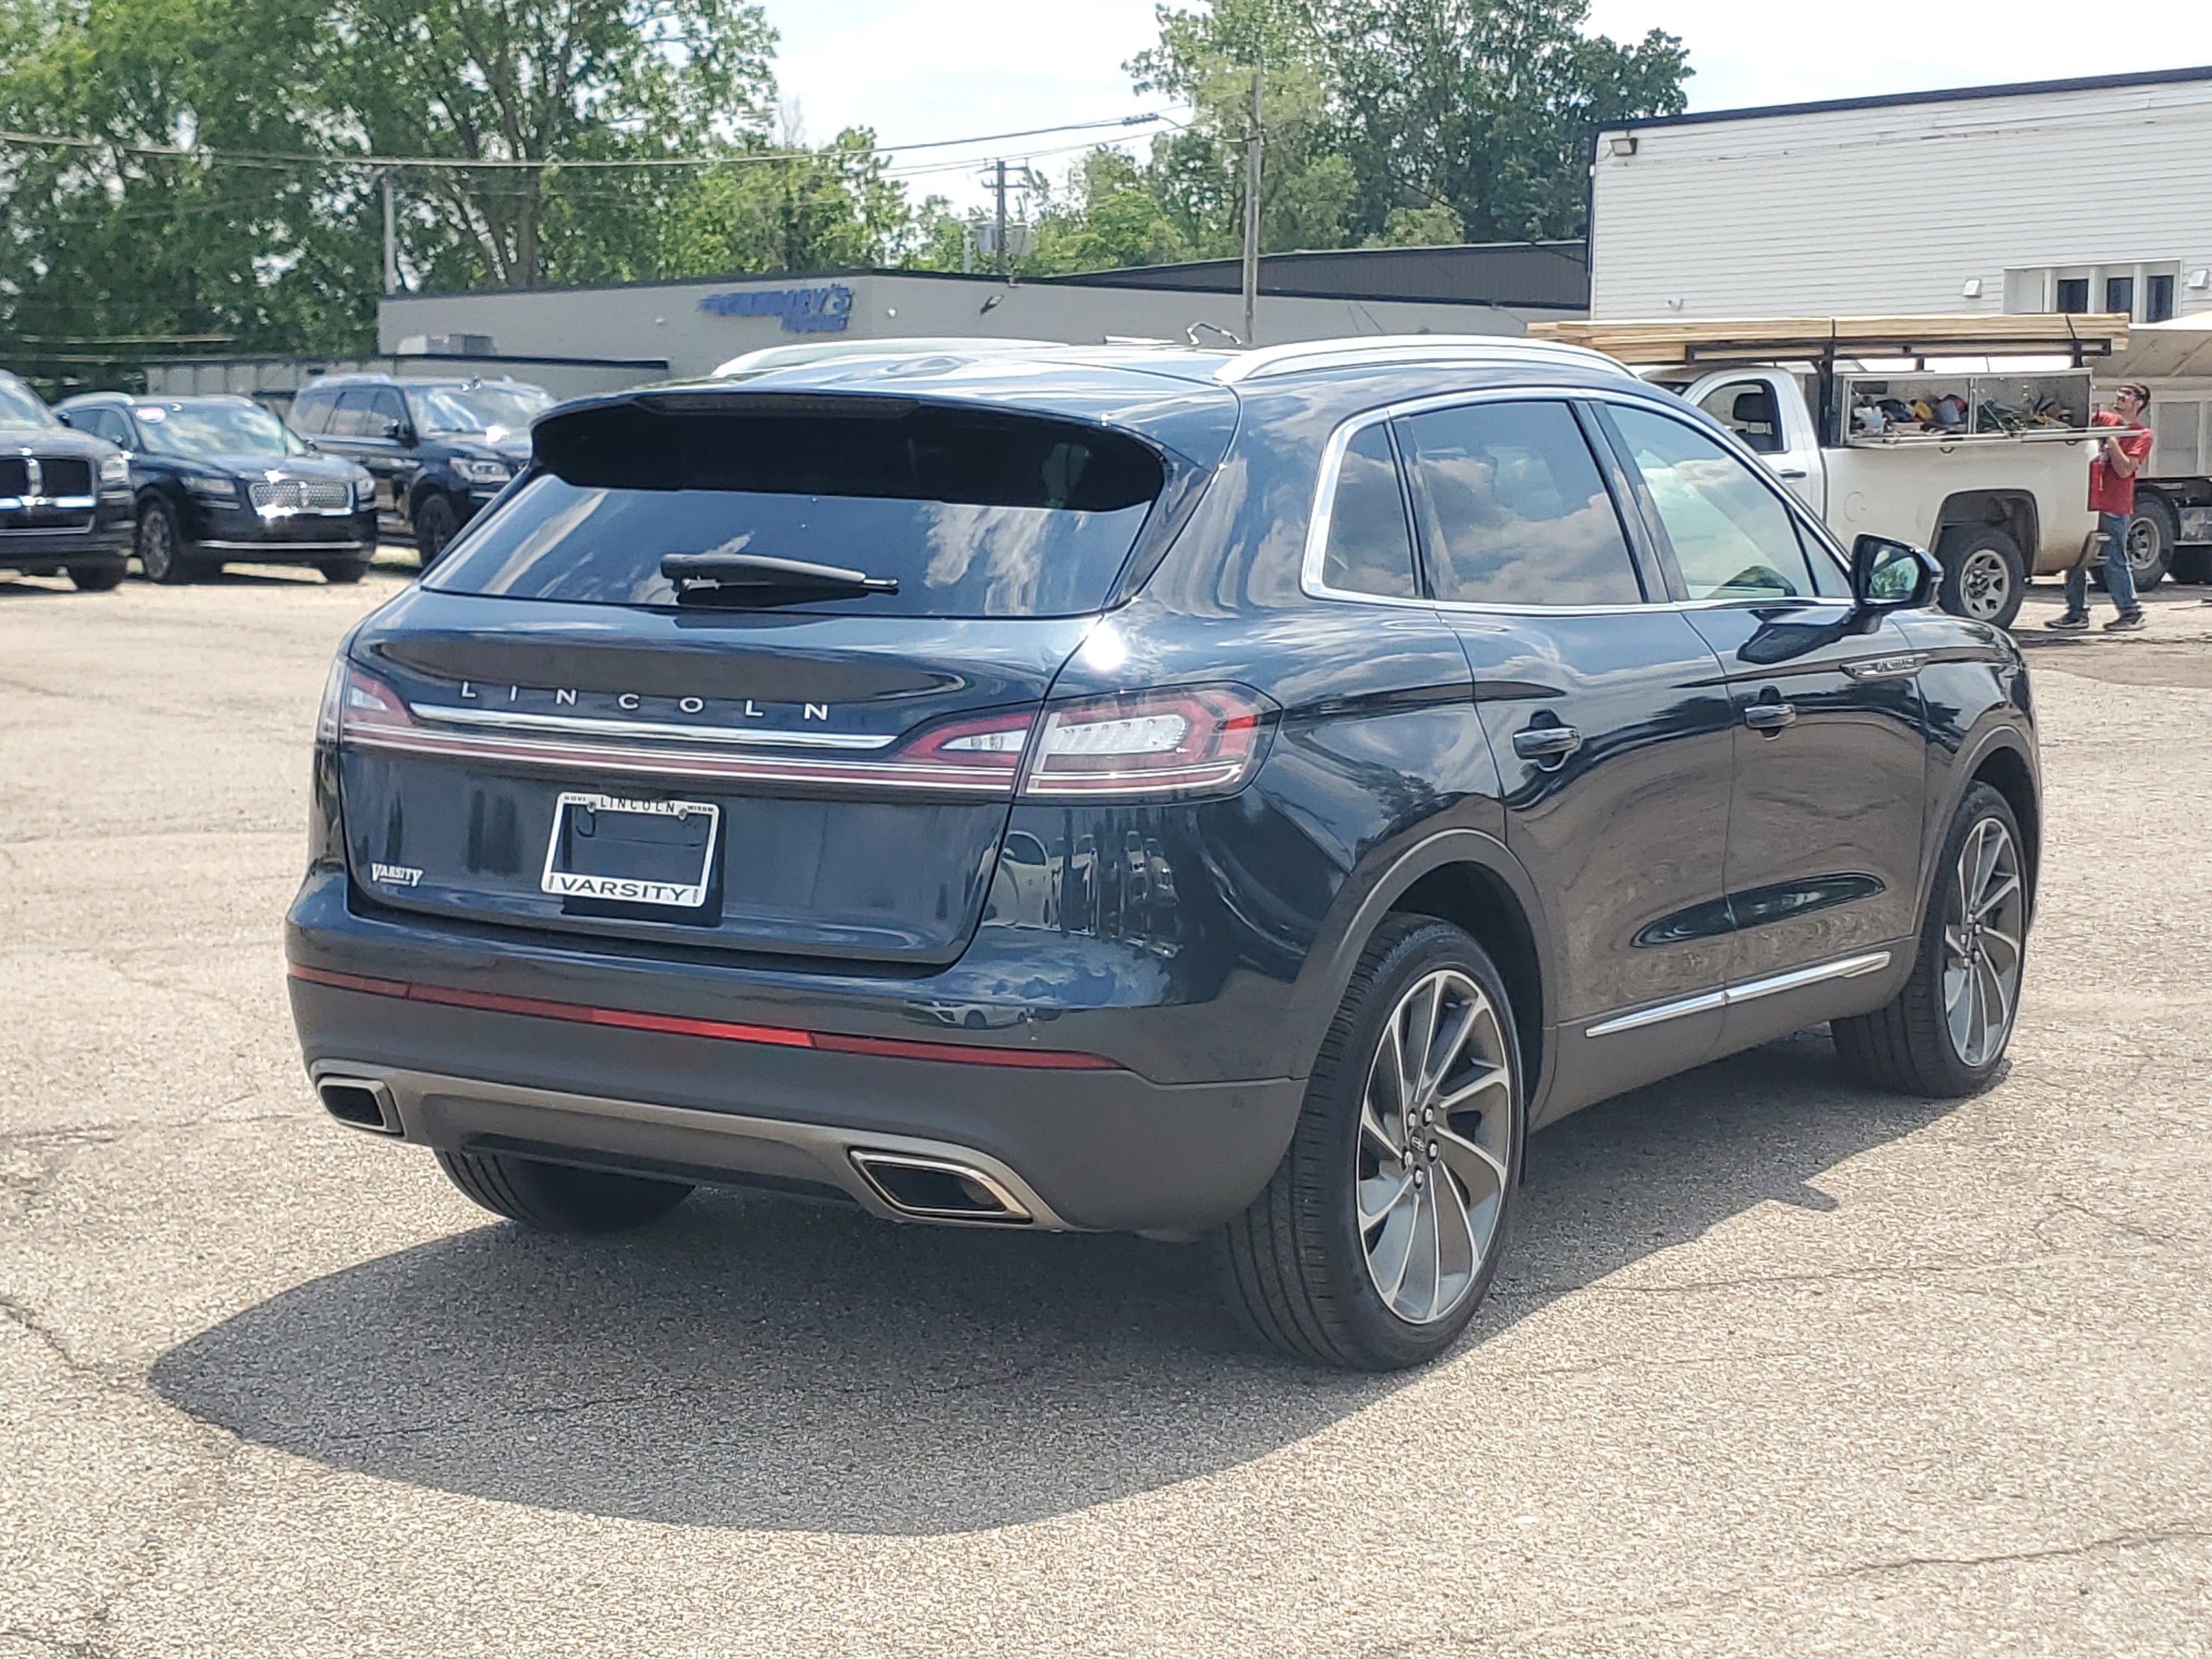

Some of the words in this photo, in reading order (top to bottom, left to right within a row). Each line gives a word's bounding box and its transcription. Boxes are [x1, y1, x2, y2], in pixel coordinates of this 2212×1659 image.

[460, 680, 828, 721] LINCOLN
[600, 796, 675, 813] LINCOLN
[371, 862, 424, 887] VARSITY
[560, 877, 689, 901] VARSITY
